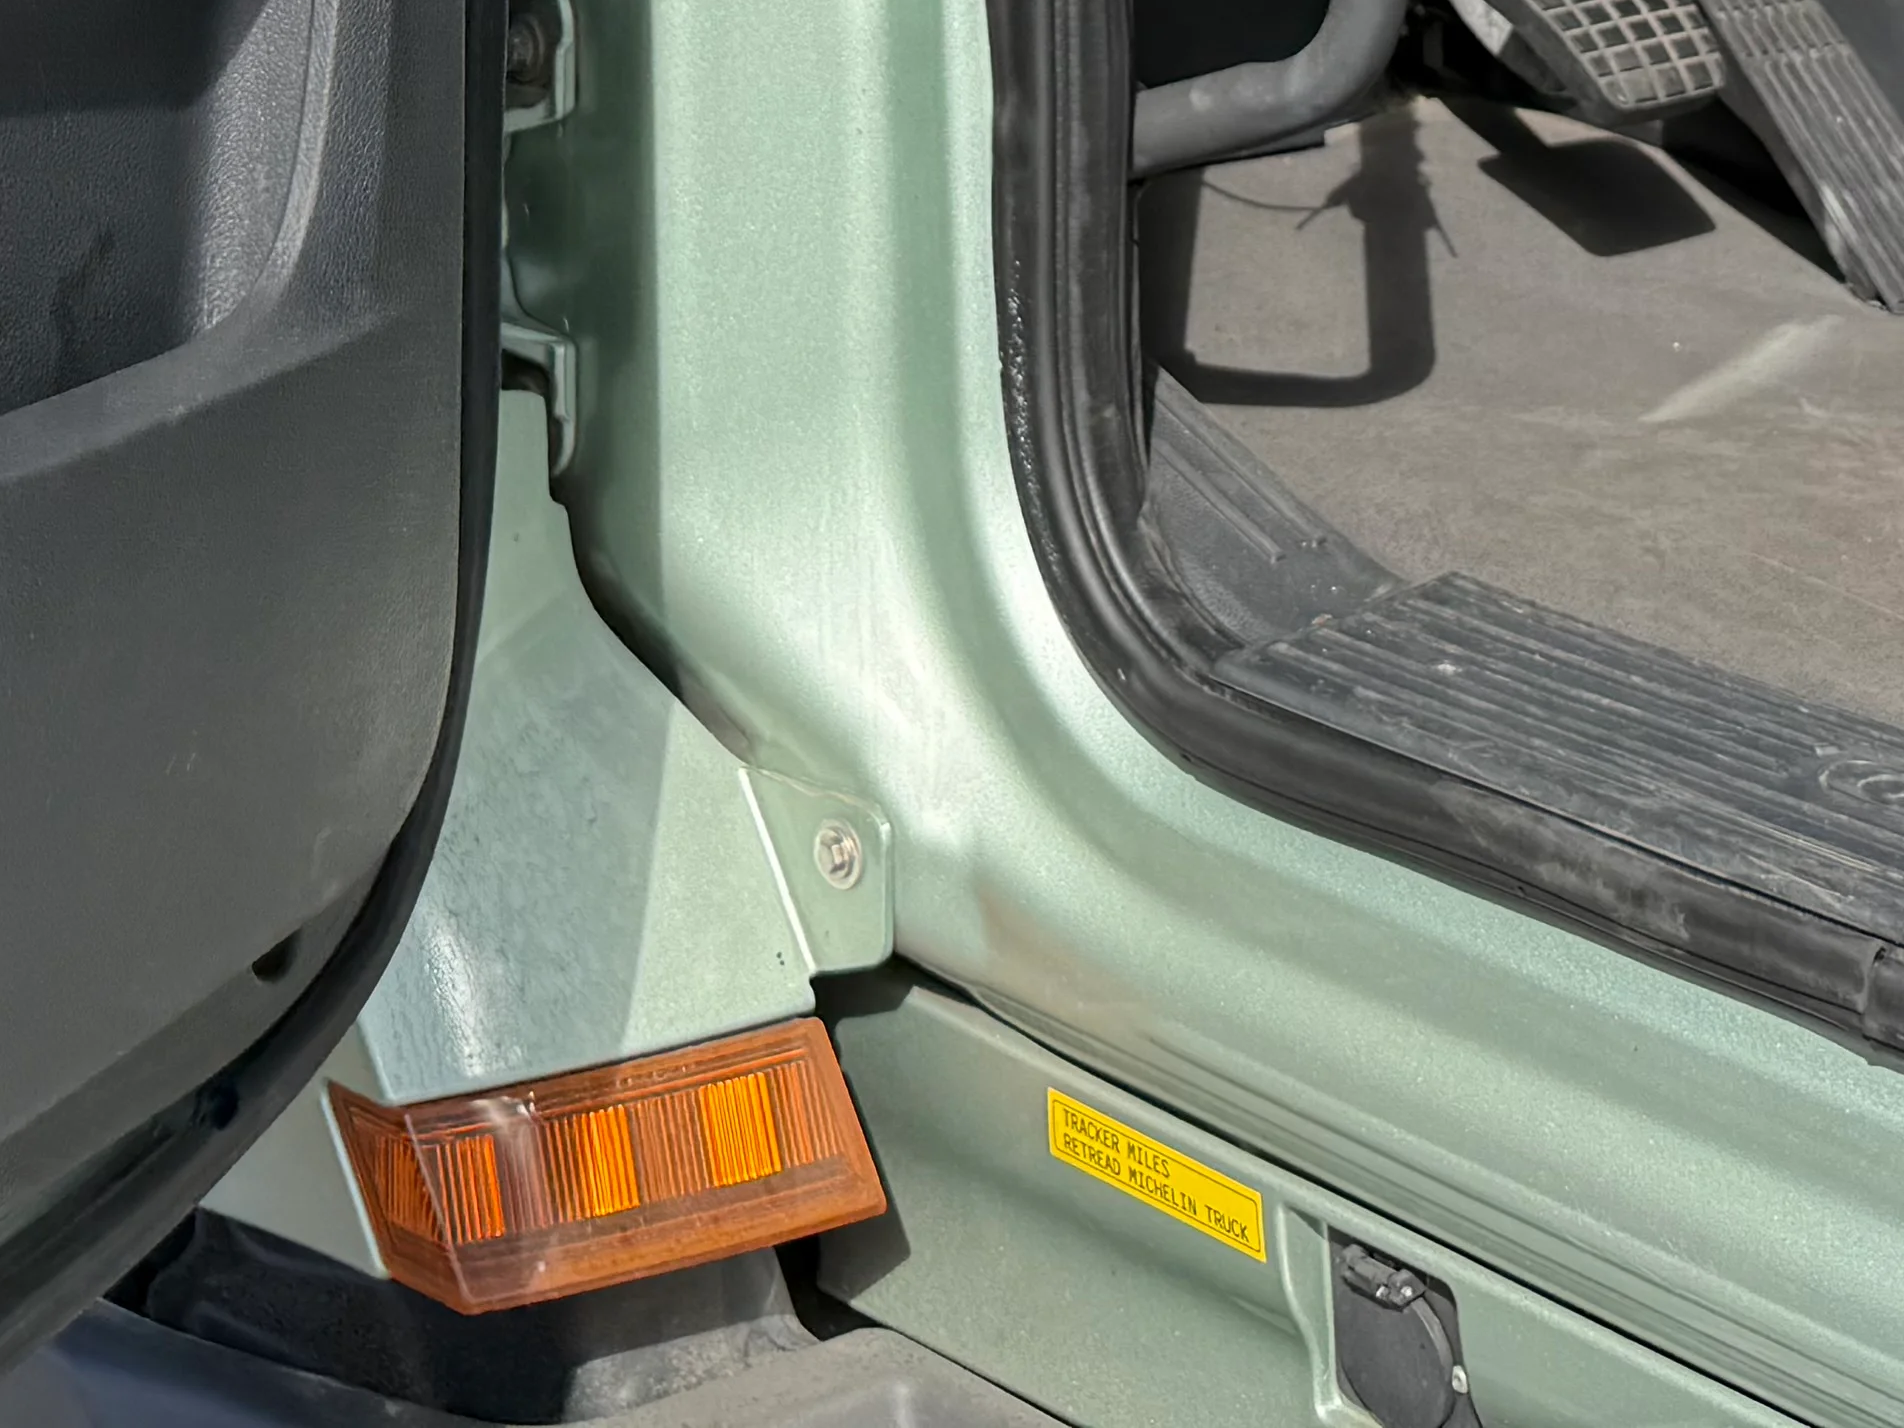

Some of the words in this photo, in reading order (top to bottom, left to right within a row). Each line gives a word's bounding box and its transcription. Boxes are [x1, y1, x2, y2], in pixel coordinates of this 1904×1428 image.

[1063, 1108, 1120, 1154] TRACKER
[1127, 1138, 1170, 1178] MILES
[1064, 1133, 1121, 1176] RETREAD
[1128, 1168, 1197, 1216] MICHELIN
[1204, 1205, 1250, 1243] TRUCK
